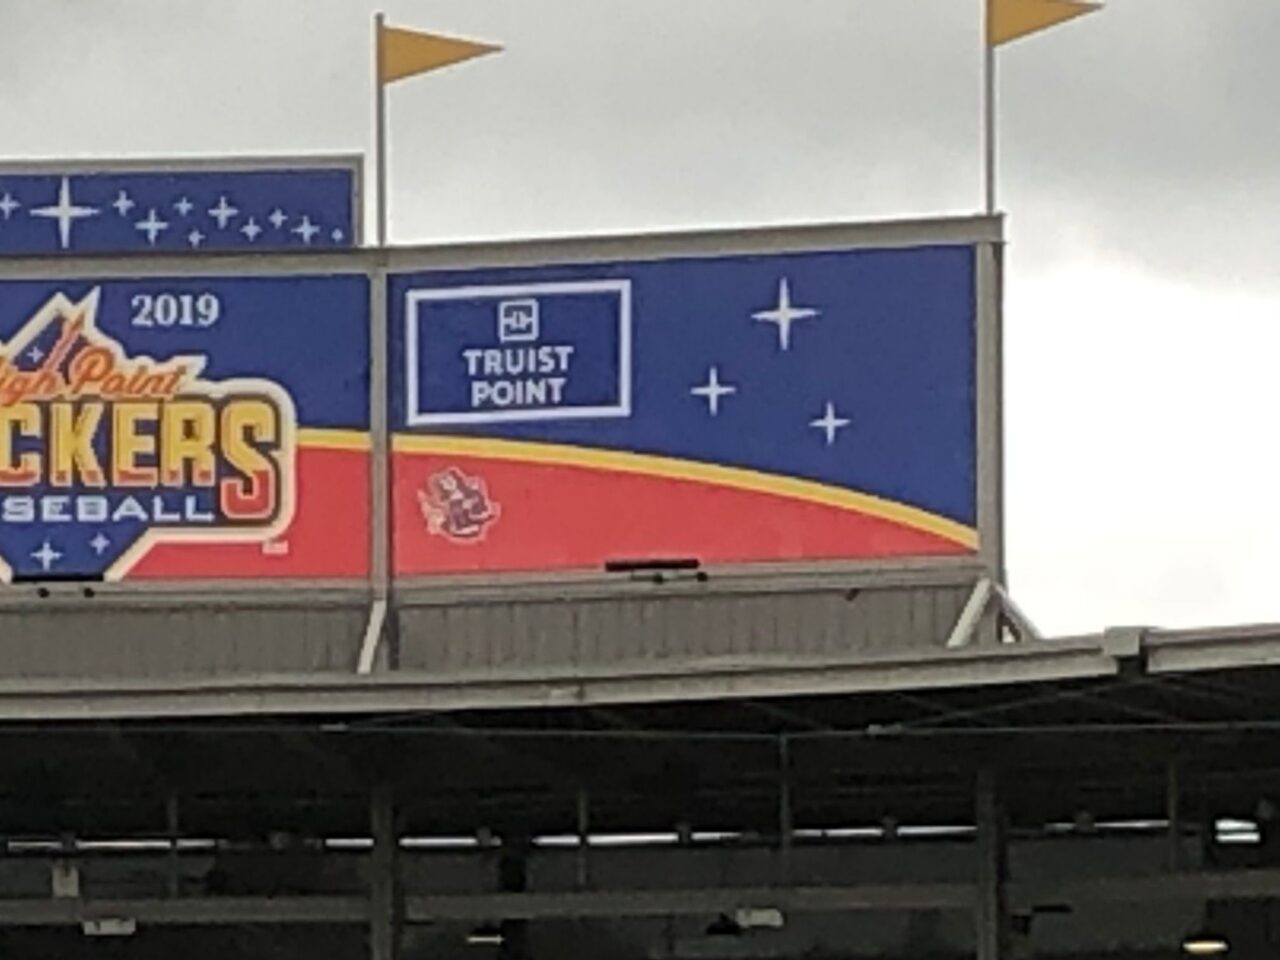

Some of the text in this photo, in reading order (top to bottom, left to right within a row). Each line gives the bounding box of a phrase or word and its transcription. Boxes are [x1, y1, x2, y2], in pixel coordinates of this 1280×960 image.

[131, 295, 219, 327] 2019
[69, 352, 195, 398] Point
[463, 346, 573, 376] TRUIST
[471, 377, 567, 407] POINT
